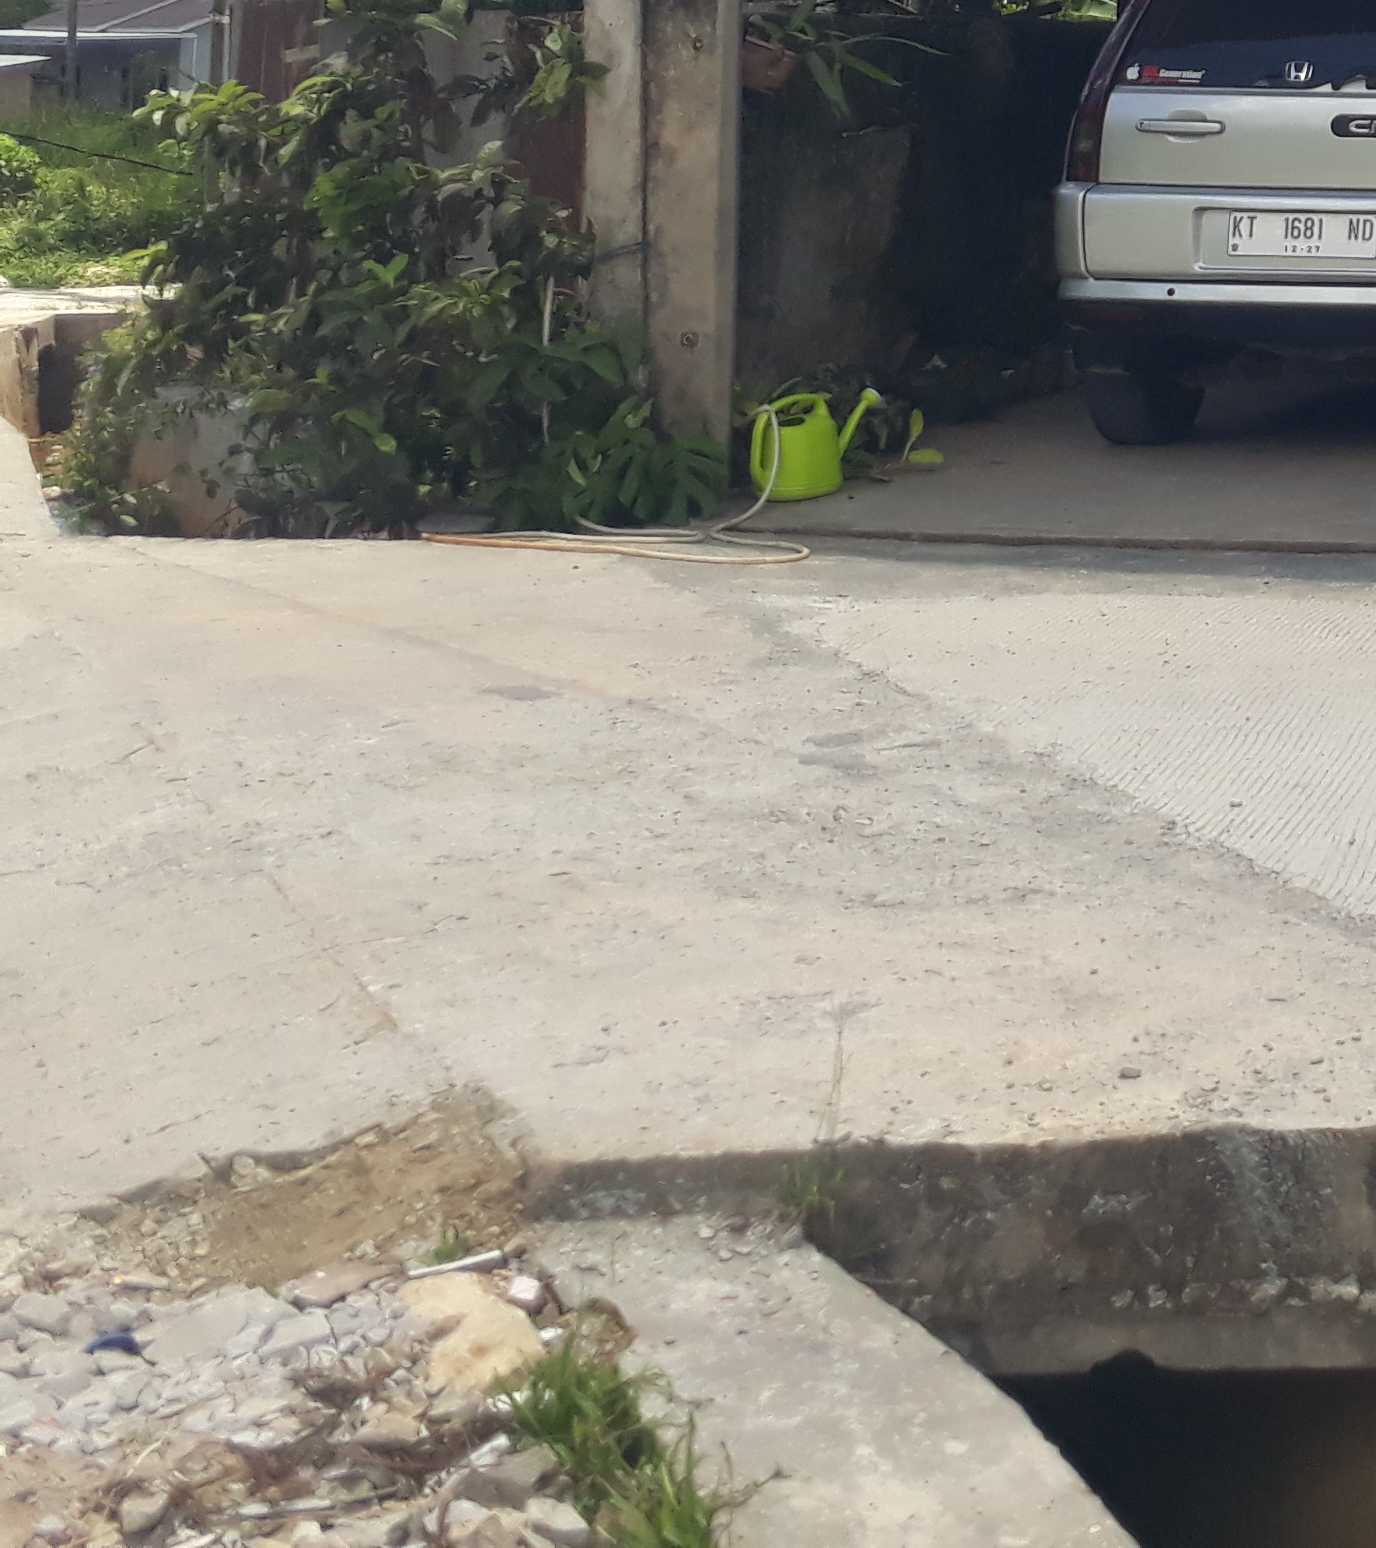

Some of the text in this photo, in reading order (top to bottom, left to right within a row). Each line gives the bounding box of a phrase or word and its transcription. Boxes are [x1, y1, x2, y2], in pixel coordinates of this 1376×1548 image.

[1232, 214, 1375, 242] KT 1681 ND
